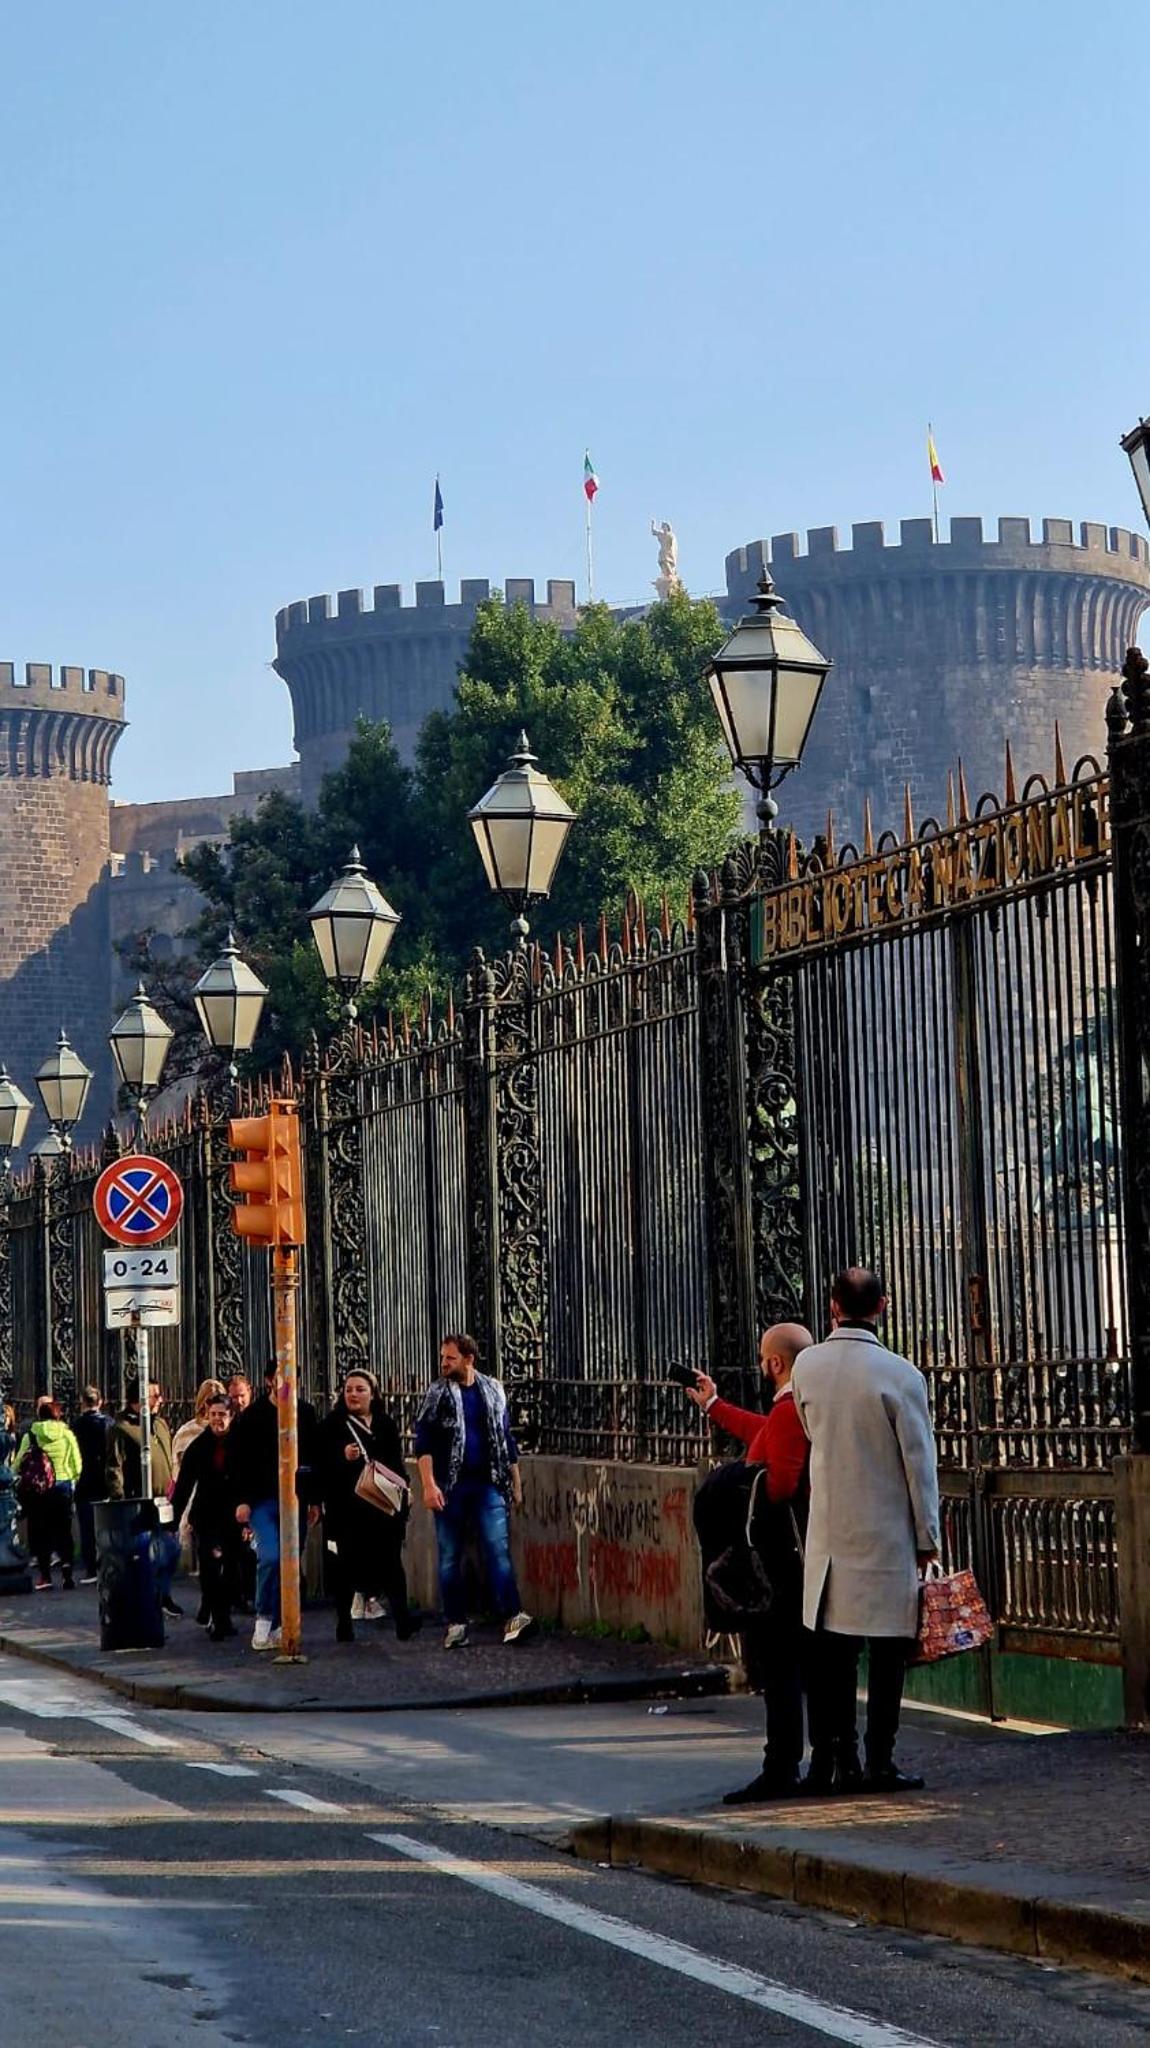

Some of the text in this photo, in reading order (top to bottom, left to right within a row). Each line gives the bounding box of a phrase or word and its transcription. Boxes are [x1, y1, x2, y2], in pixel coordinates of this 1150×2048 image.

[764, 784, 1111, 954] BIBLIOTECA NAZIONALE
[113, 1260, 168, 1277] 0-24
